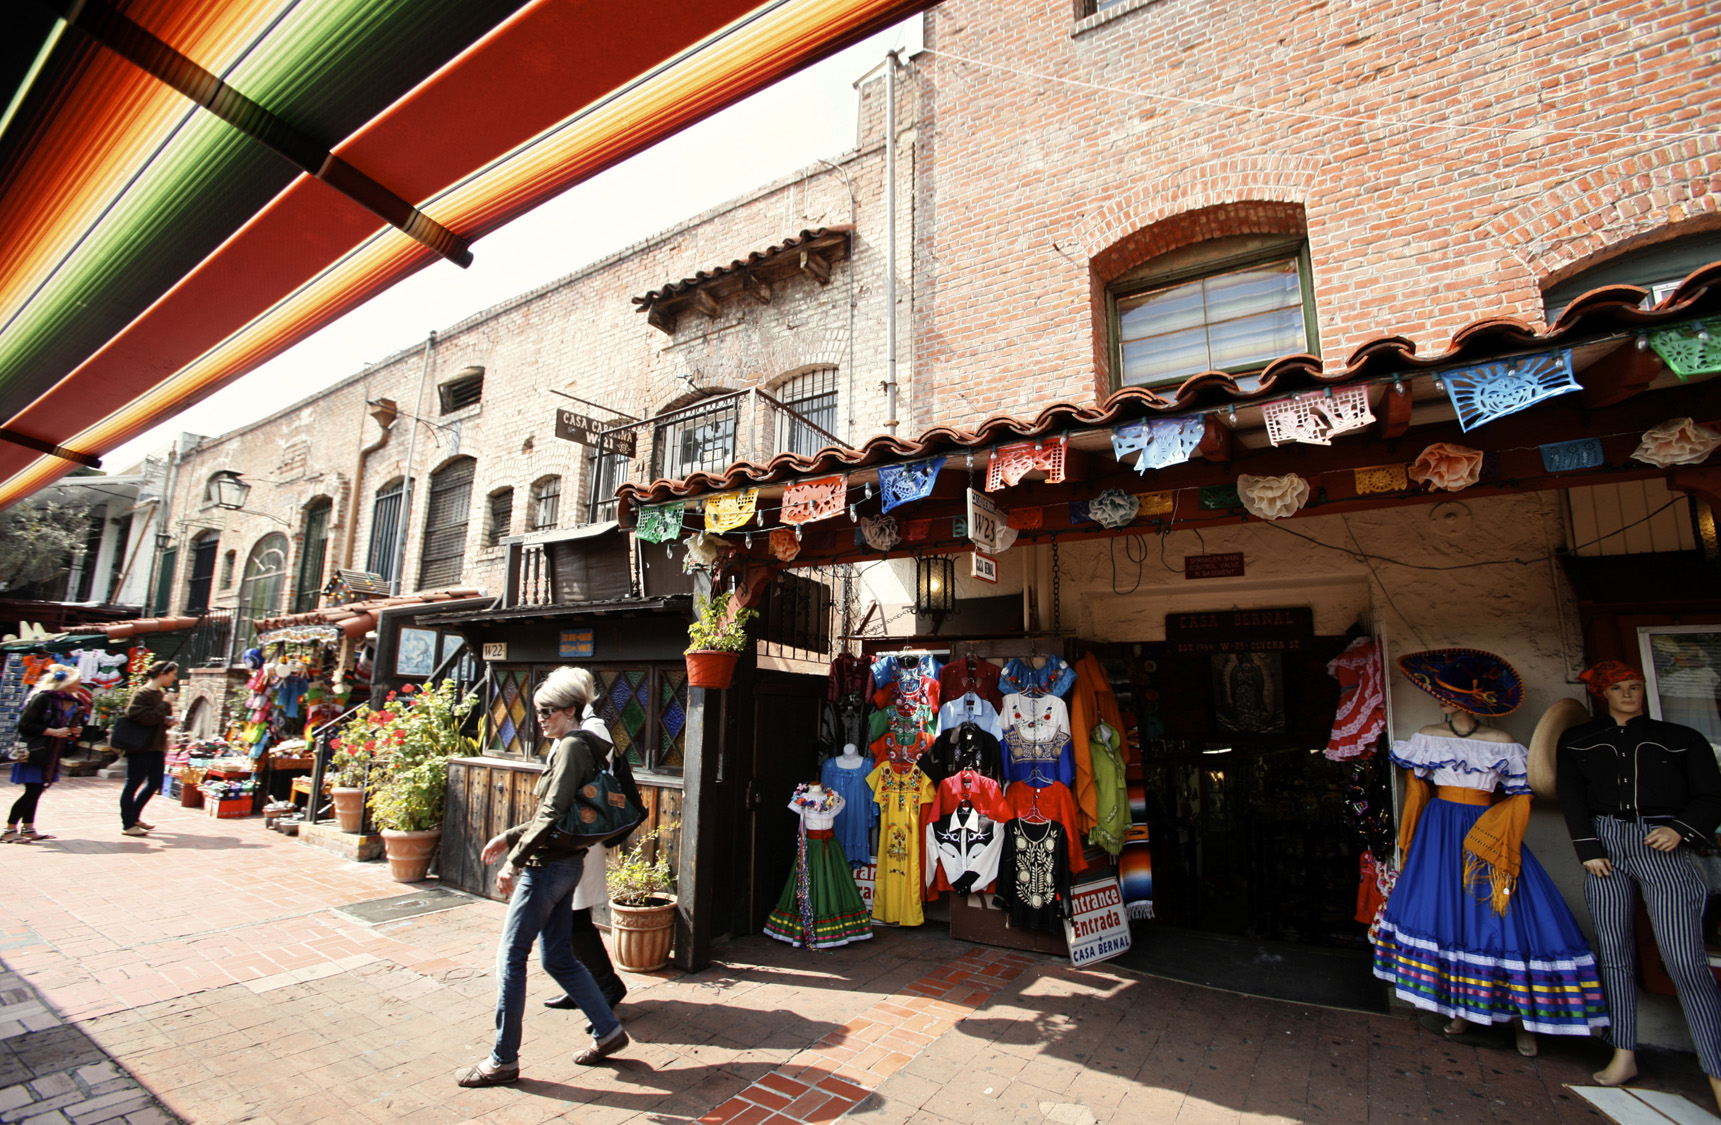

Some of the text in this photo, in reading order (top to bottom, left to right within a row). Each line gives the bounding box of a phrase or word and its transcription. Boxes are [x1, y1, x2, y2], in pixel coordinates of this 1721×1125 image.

[563, 412, 588, 430] CASA
[974, 512, 996, 542] W23
[1179, 611, 1295, 629] CASA BERNAL
[1072, 889, 1118, 914] ntrance
[1074, 910, 1120, 938] Entrada
[1073, 936, 1129, 962] CASA BERNAL
